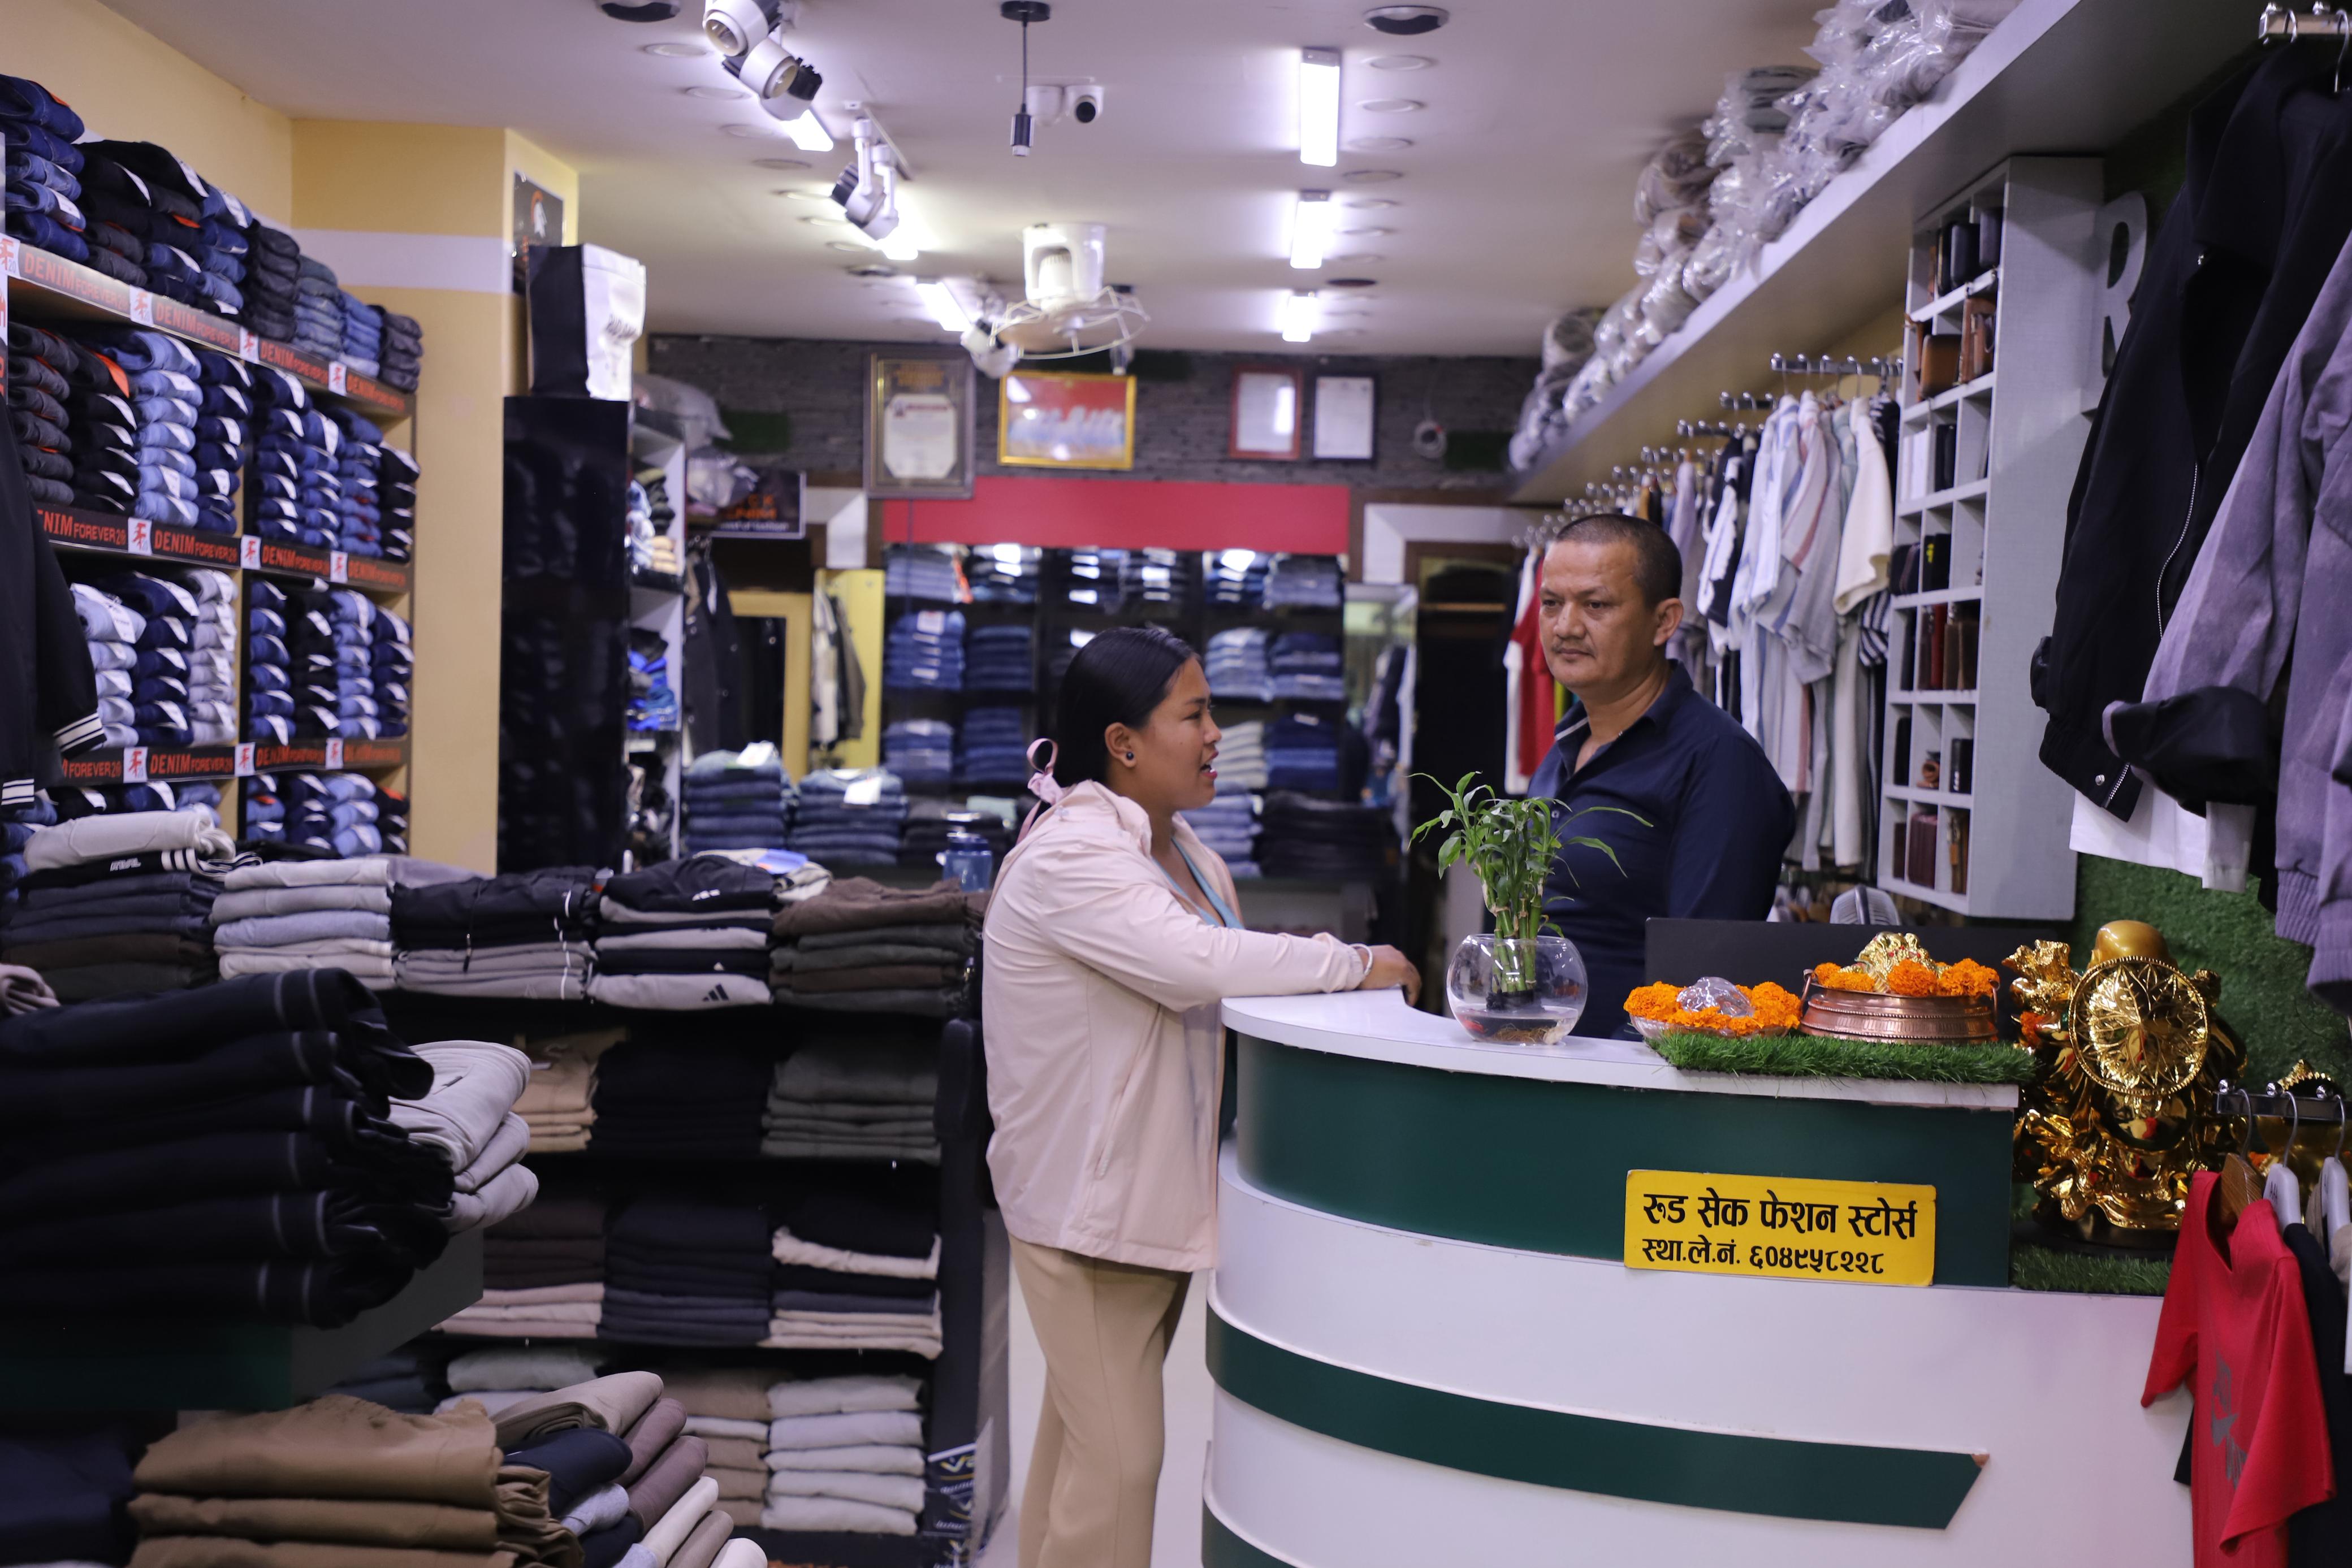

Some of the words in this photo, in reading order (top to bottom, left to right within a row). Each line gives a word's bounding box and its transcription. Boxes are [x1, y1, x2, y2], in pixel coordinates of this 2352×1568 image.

[24, 253, 75, 289] DENIM
[155, 302, 197, 334] DENIM
[260, 340, 294, 373] DENIM
[37, 509, 73, 536] NIM
[154, 529, 195, 555] DENIM
[262, 544, 296, 568] DENIM
[150, 753, 192, 774] DENIM
[1697, 1187, 1750, 1228] सेक
[1759, 1189, 1839, 1233] फेशन
[1848, 1197, 1918, 1240] स्टोर्स
